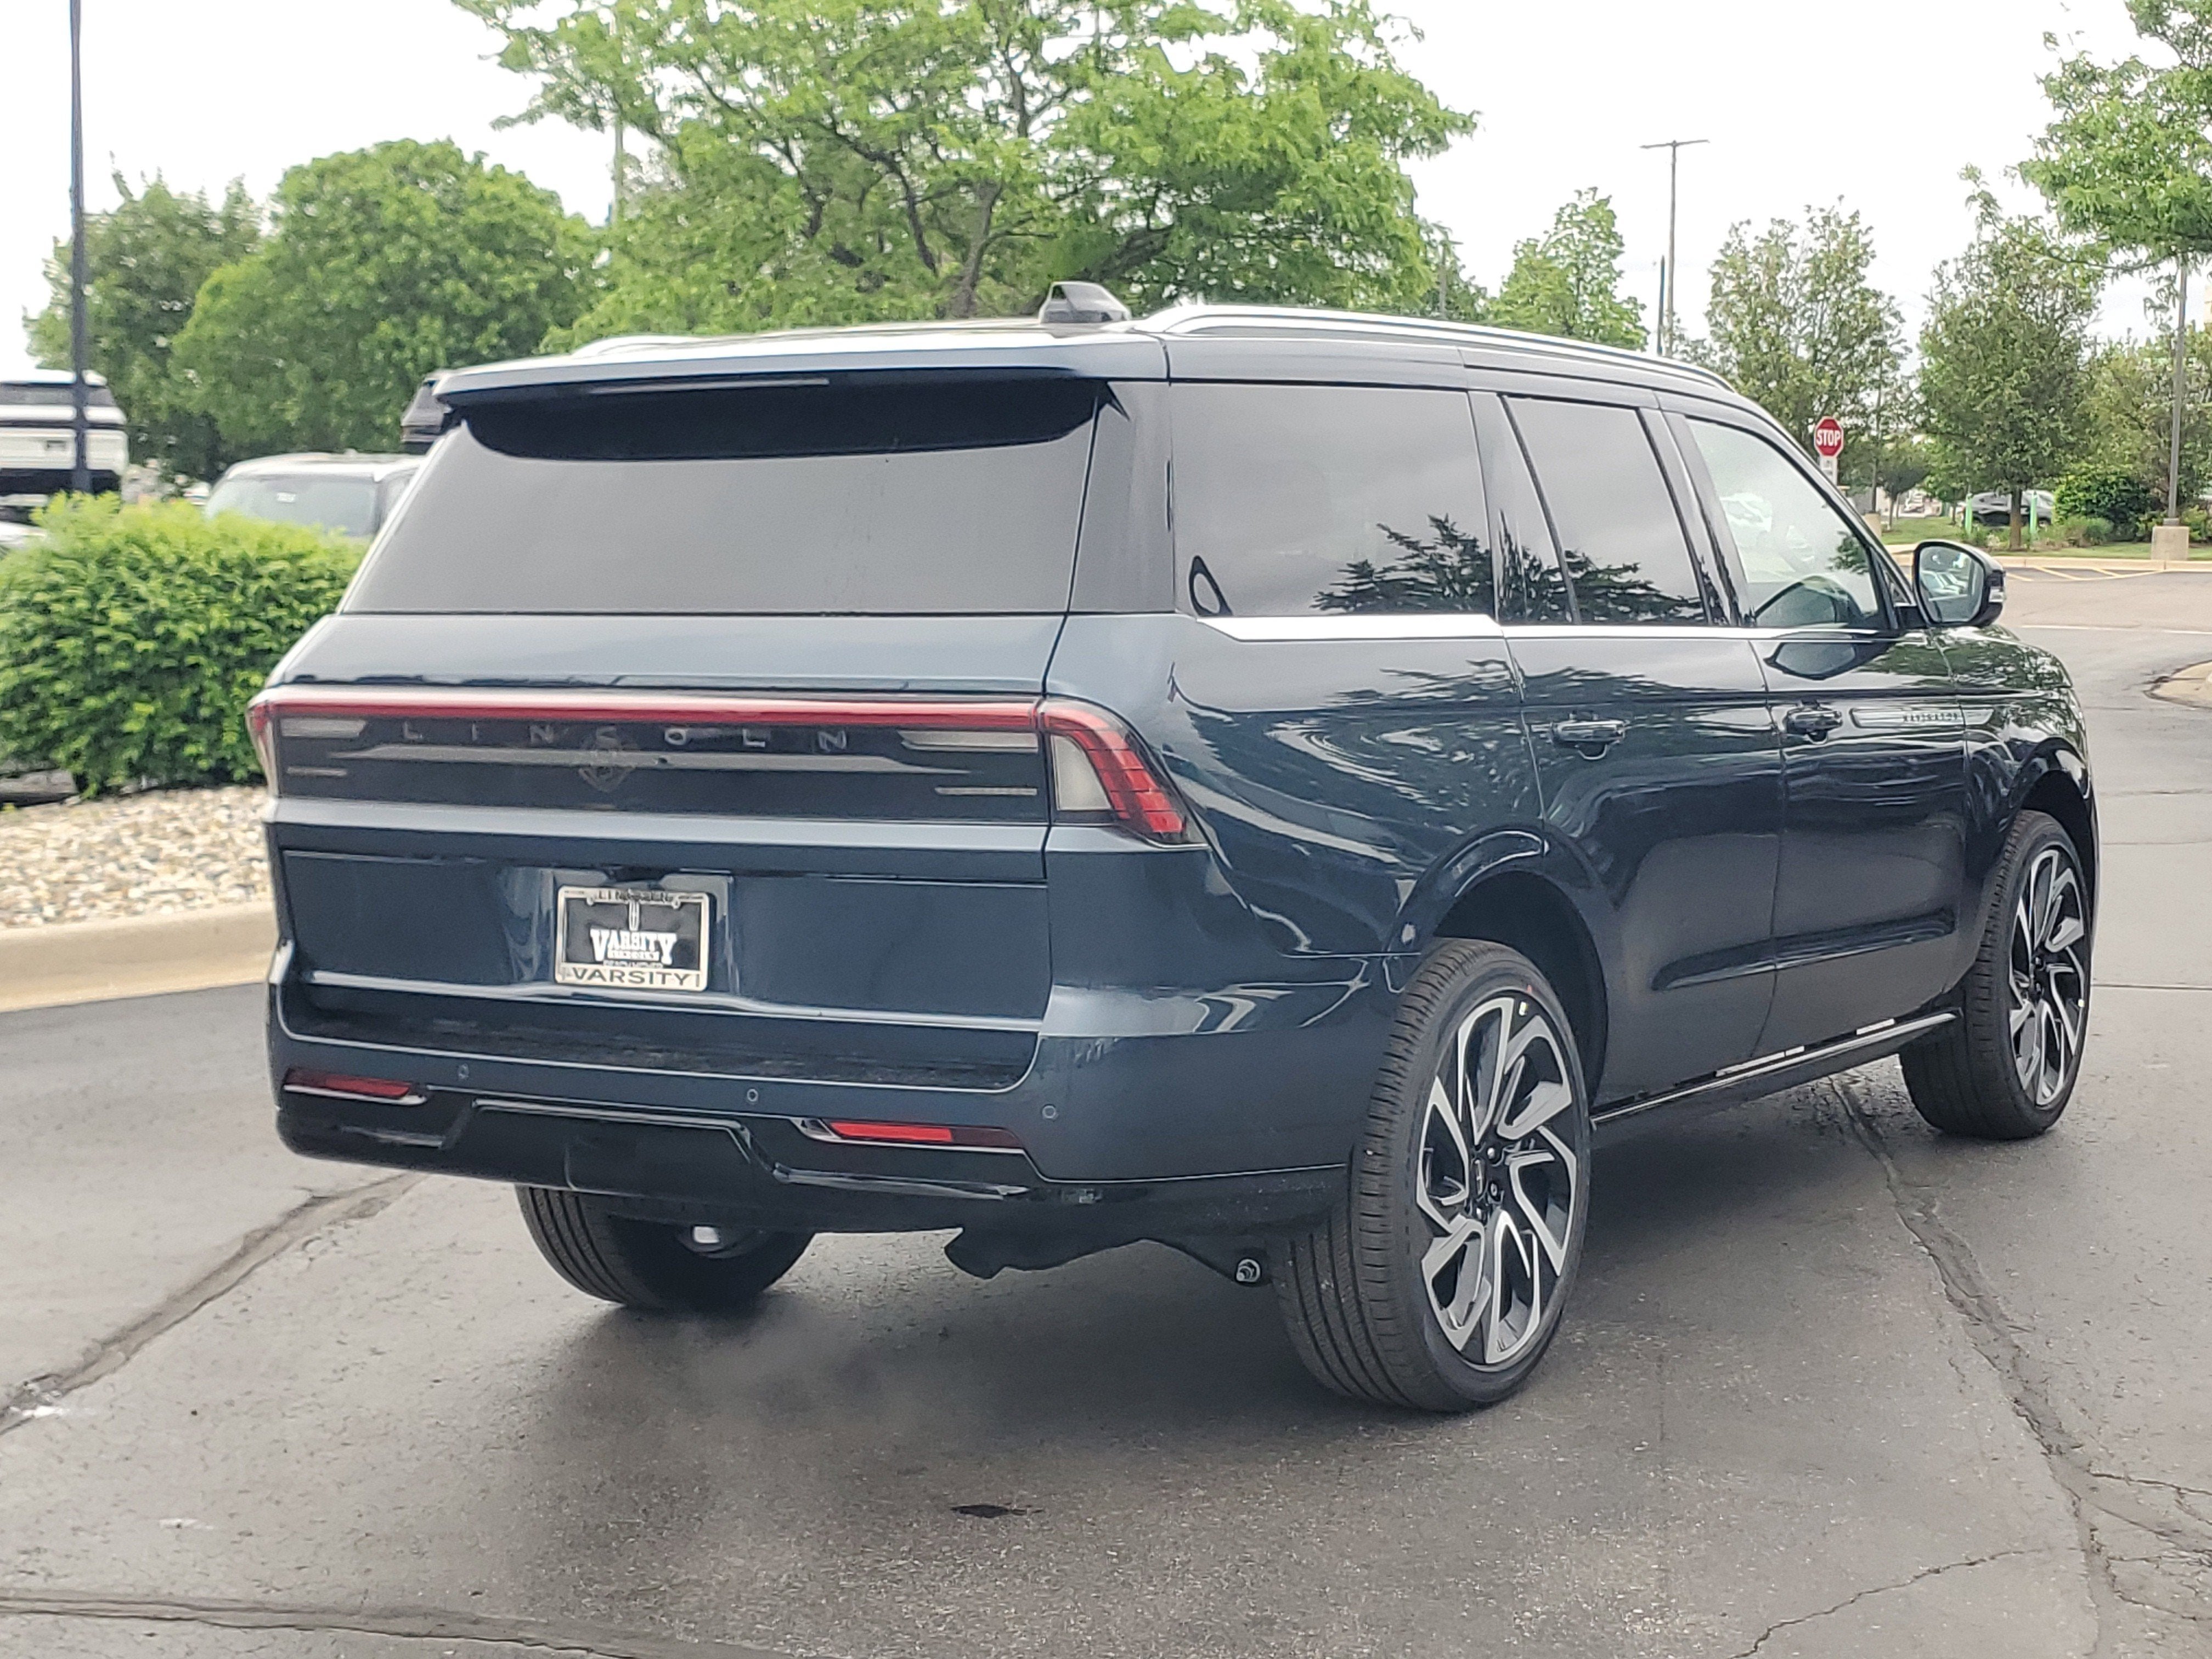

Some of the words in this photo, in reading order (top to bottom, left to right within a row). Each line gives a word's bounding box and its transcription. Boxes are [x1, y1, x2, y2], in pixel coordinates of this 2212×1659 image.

[1816, 429, 1841, 447] STOP
[598, 889, 668, 902] LINLN
[590, 929, 677, 966] VARSITY
[572, 967, 690, 986] VARSITY
